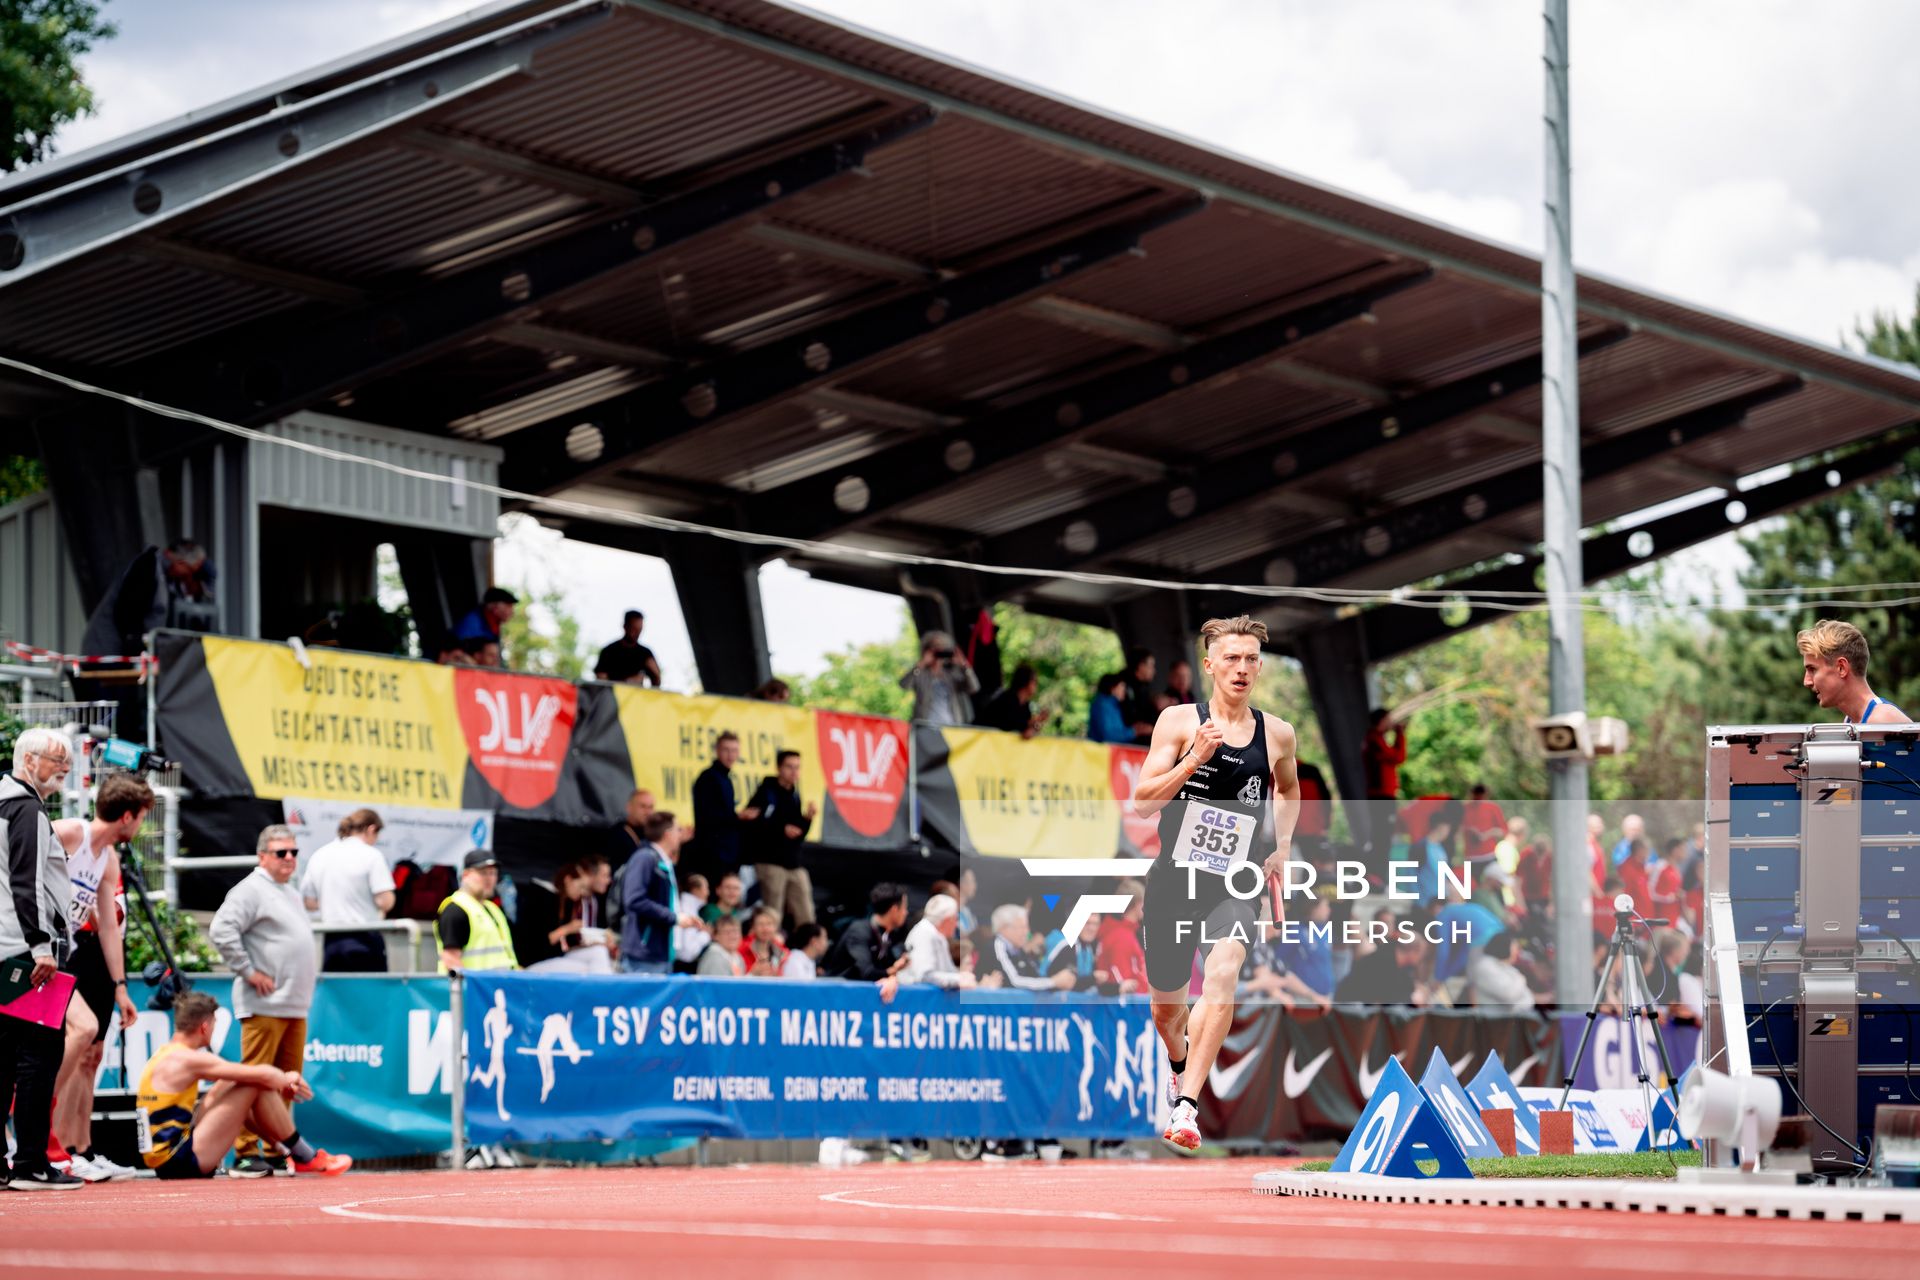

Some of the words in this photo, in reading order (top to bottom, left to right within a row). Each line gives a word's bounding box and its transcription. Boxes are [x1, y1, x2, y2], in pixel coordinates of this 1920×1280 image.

[304, 665, 400, 703] DEUTSCHE
[271, 707, 434, 755] LEICHTATHLETIK
[475, 688, 561, 756] DLV
[680, 723, 786, 765] HERICH
[262, 756, 451, 800] MEISTERSCHAFTEN
[975, 775, 1020, 815] VIEL
[1190, 824, 1240, 856] 353
[593, 1006, 650, 1045] TSV
[660, 1006, 770, 1046] SCHOTT
[780, 1009, 863, 1047] MAINZ
[873, 1012, 1070, 1053] LEICHTATHLETIK
[303, 1038, 384, 1068] cherung
[673, 1076, 716, 1100] DEIN
[784, 1076, 819, 1101] DEIN
[878, 1077, 918, 1101] DEINE
